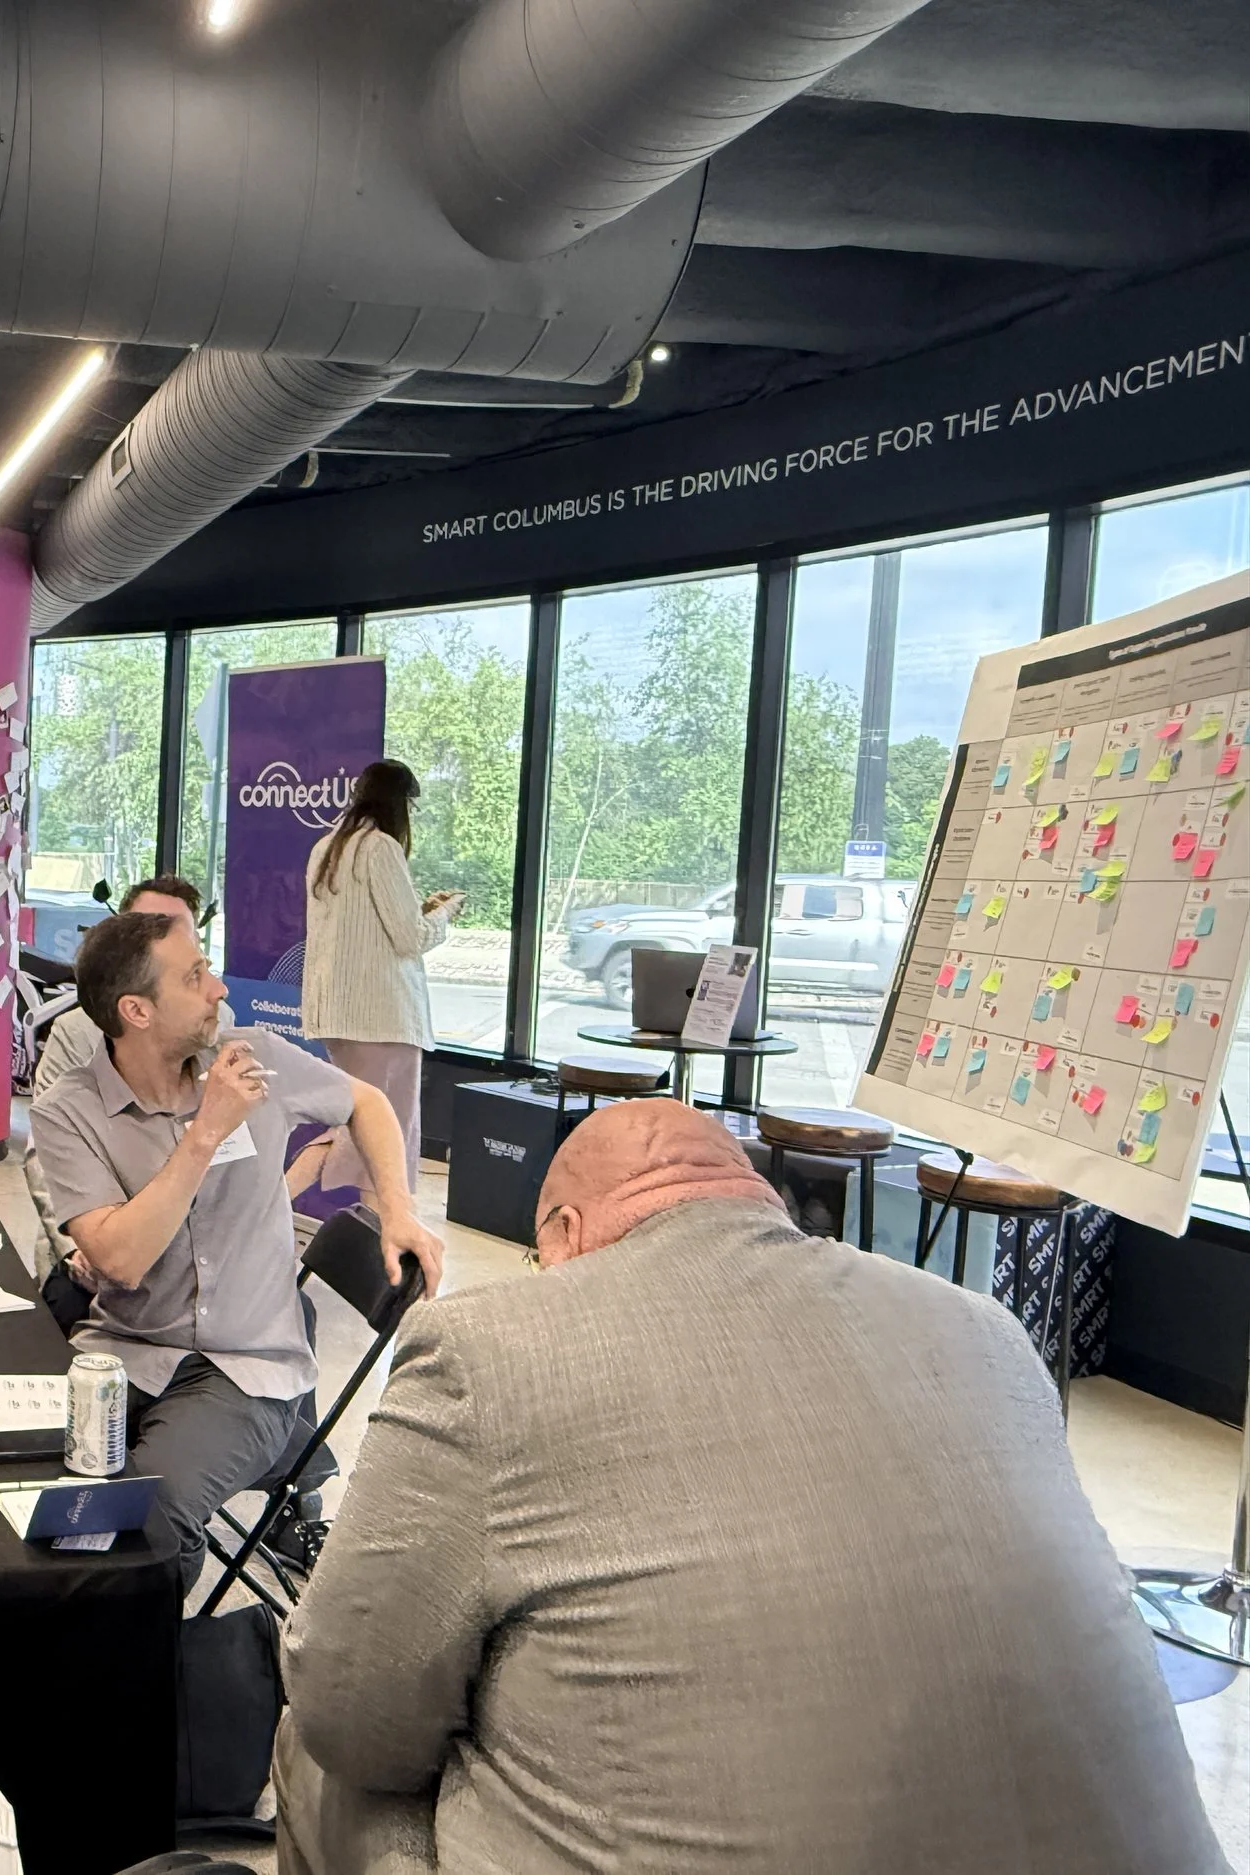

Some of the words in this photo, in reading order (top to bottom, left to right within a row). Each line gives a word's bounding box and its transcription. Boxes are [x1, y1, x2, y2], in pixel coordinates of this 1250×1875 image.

[422, 515, 488, 543] SMART
[493, 494, 601, 532] COLUMBUS
[607, 489, 625, 511] IS
[632, 479, 674, 506] THE
[680, 458, 778, 498] DRIVING
[784, 436, 869, 477] FORCE
[876, 421, 934, 456] FOR
[943, 404, 1001, 440] THE
[1009, 332, 1250, 426] ADVANCEMEN
